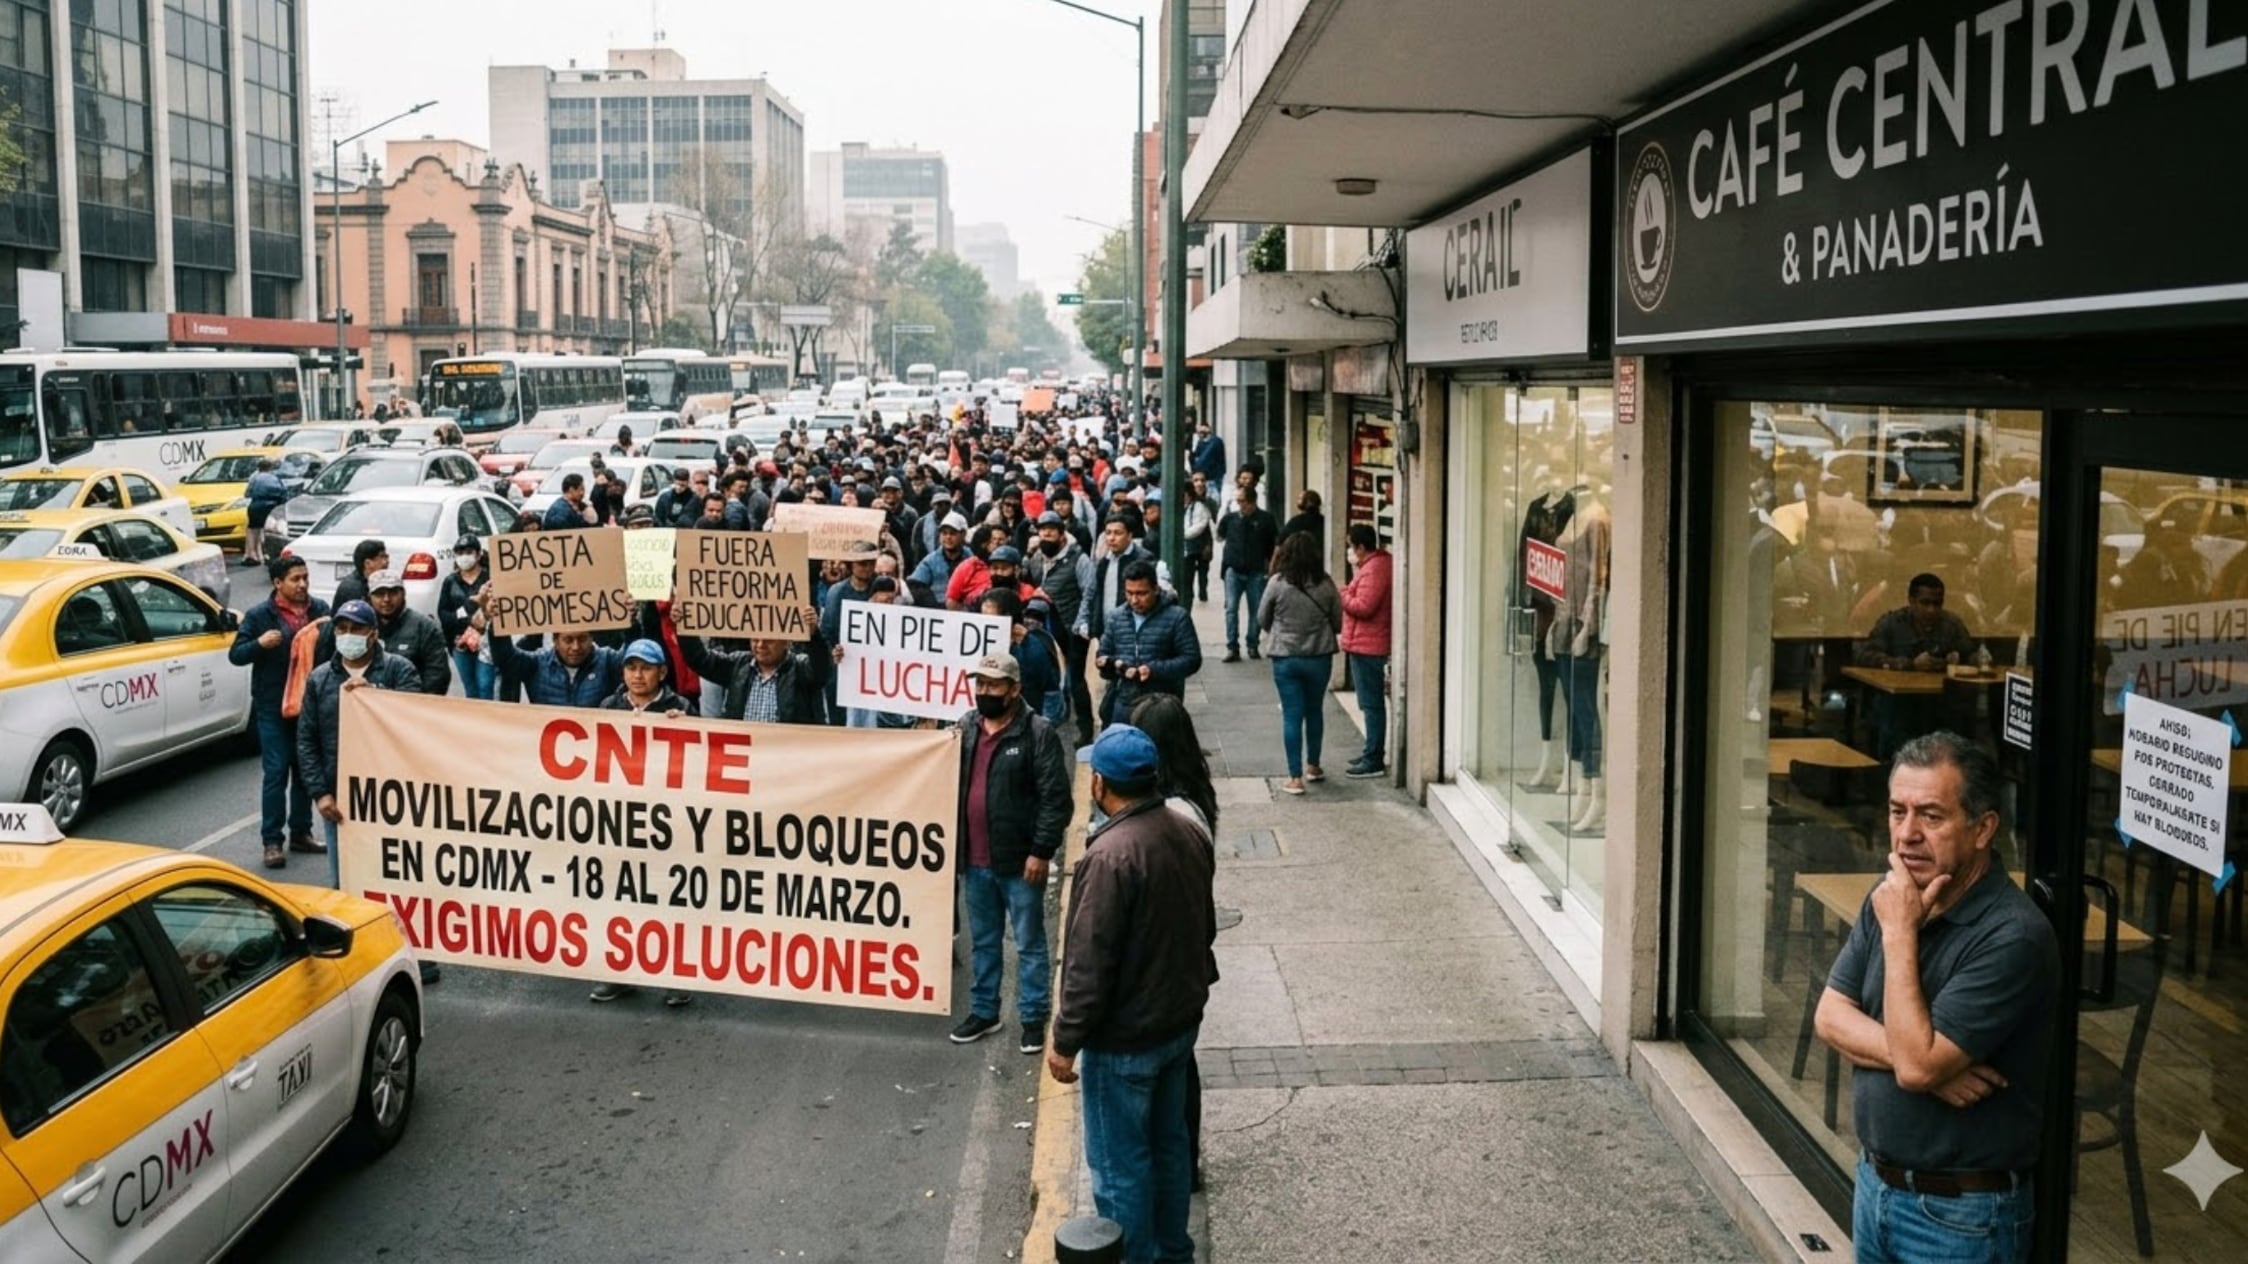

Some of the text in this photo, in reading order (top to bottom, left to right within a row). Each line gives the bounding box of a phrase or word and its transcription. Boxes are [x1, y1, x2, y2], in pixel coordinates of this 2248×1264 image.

[1687, 0, 2247, 220] CAFÉ CENTRAL
[1781, 163, 2044, 285] & PANADERÍA
[159, 440, 207, 466] CDMX
[497, 534, 593, 571] BASTA
[700, 536, 776, 567] FUERA
[540, 572, 565, 590] DE
[689, 569, 798, 600] REFORMA
[497, 589, 628, 629] PROMESAS
[681, 602, 805, 634] EDUCATIVA
[848, 609, 886, 646] EN
[900, 615, 944, 653] PIE
[101, 672, 159, 709] CDMX
[860, 657, 974, 707] LUCHA
[539, 718, 752, 795] CNTE
[348, 775, 945, 873] MOVILIZACIONES Y BLOQUEOS
[381, 838, 910, 929] EN CDMX - 18 AL 20 DE MARZO.
[605, 915, 934, 1001] SOLUCIONES.
[278, 1050, 313, 1102] TAXI
[112, 1108, 215, 1228] CDMX
